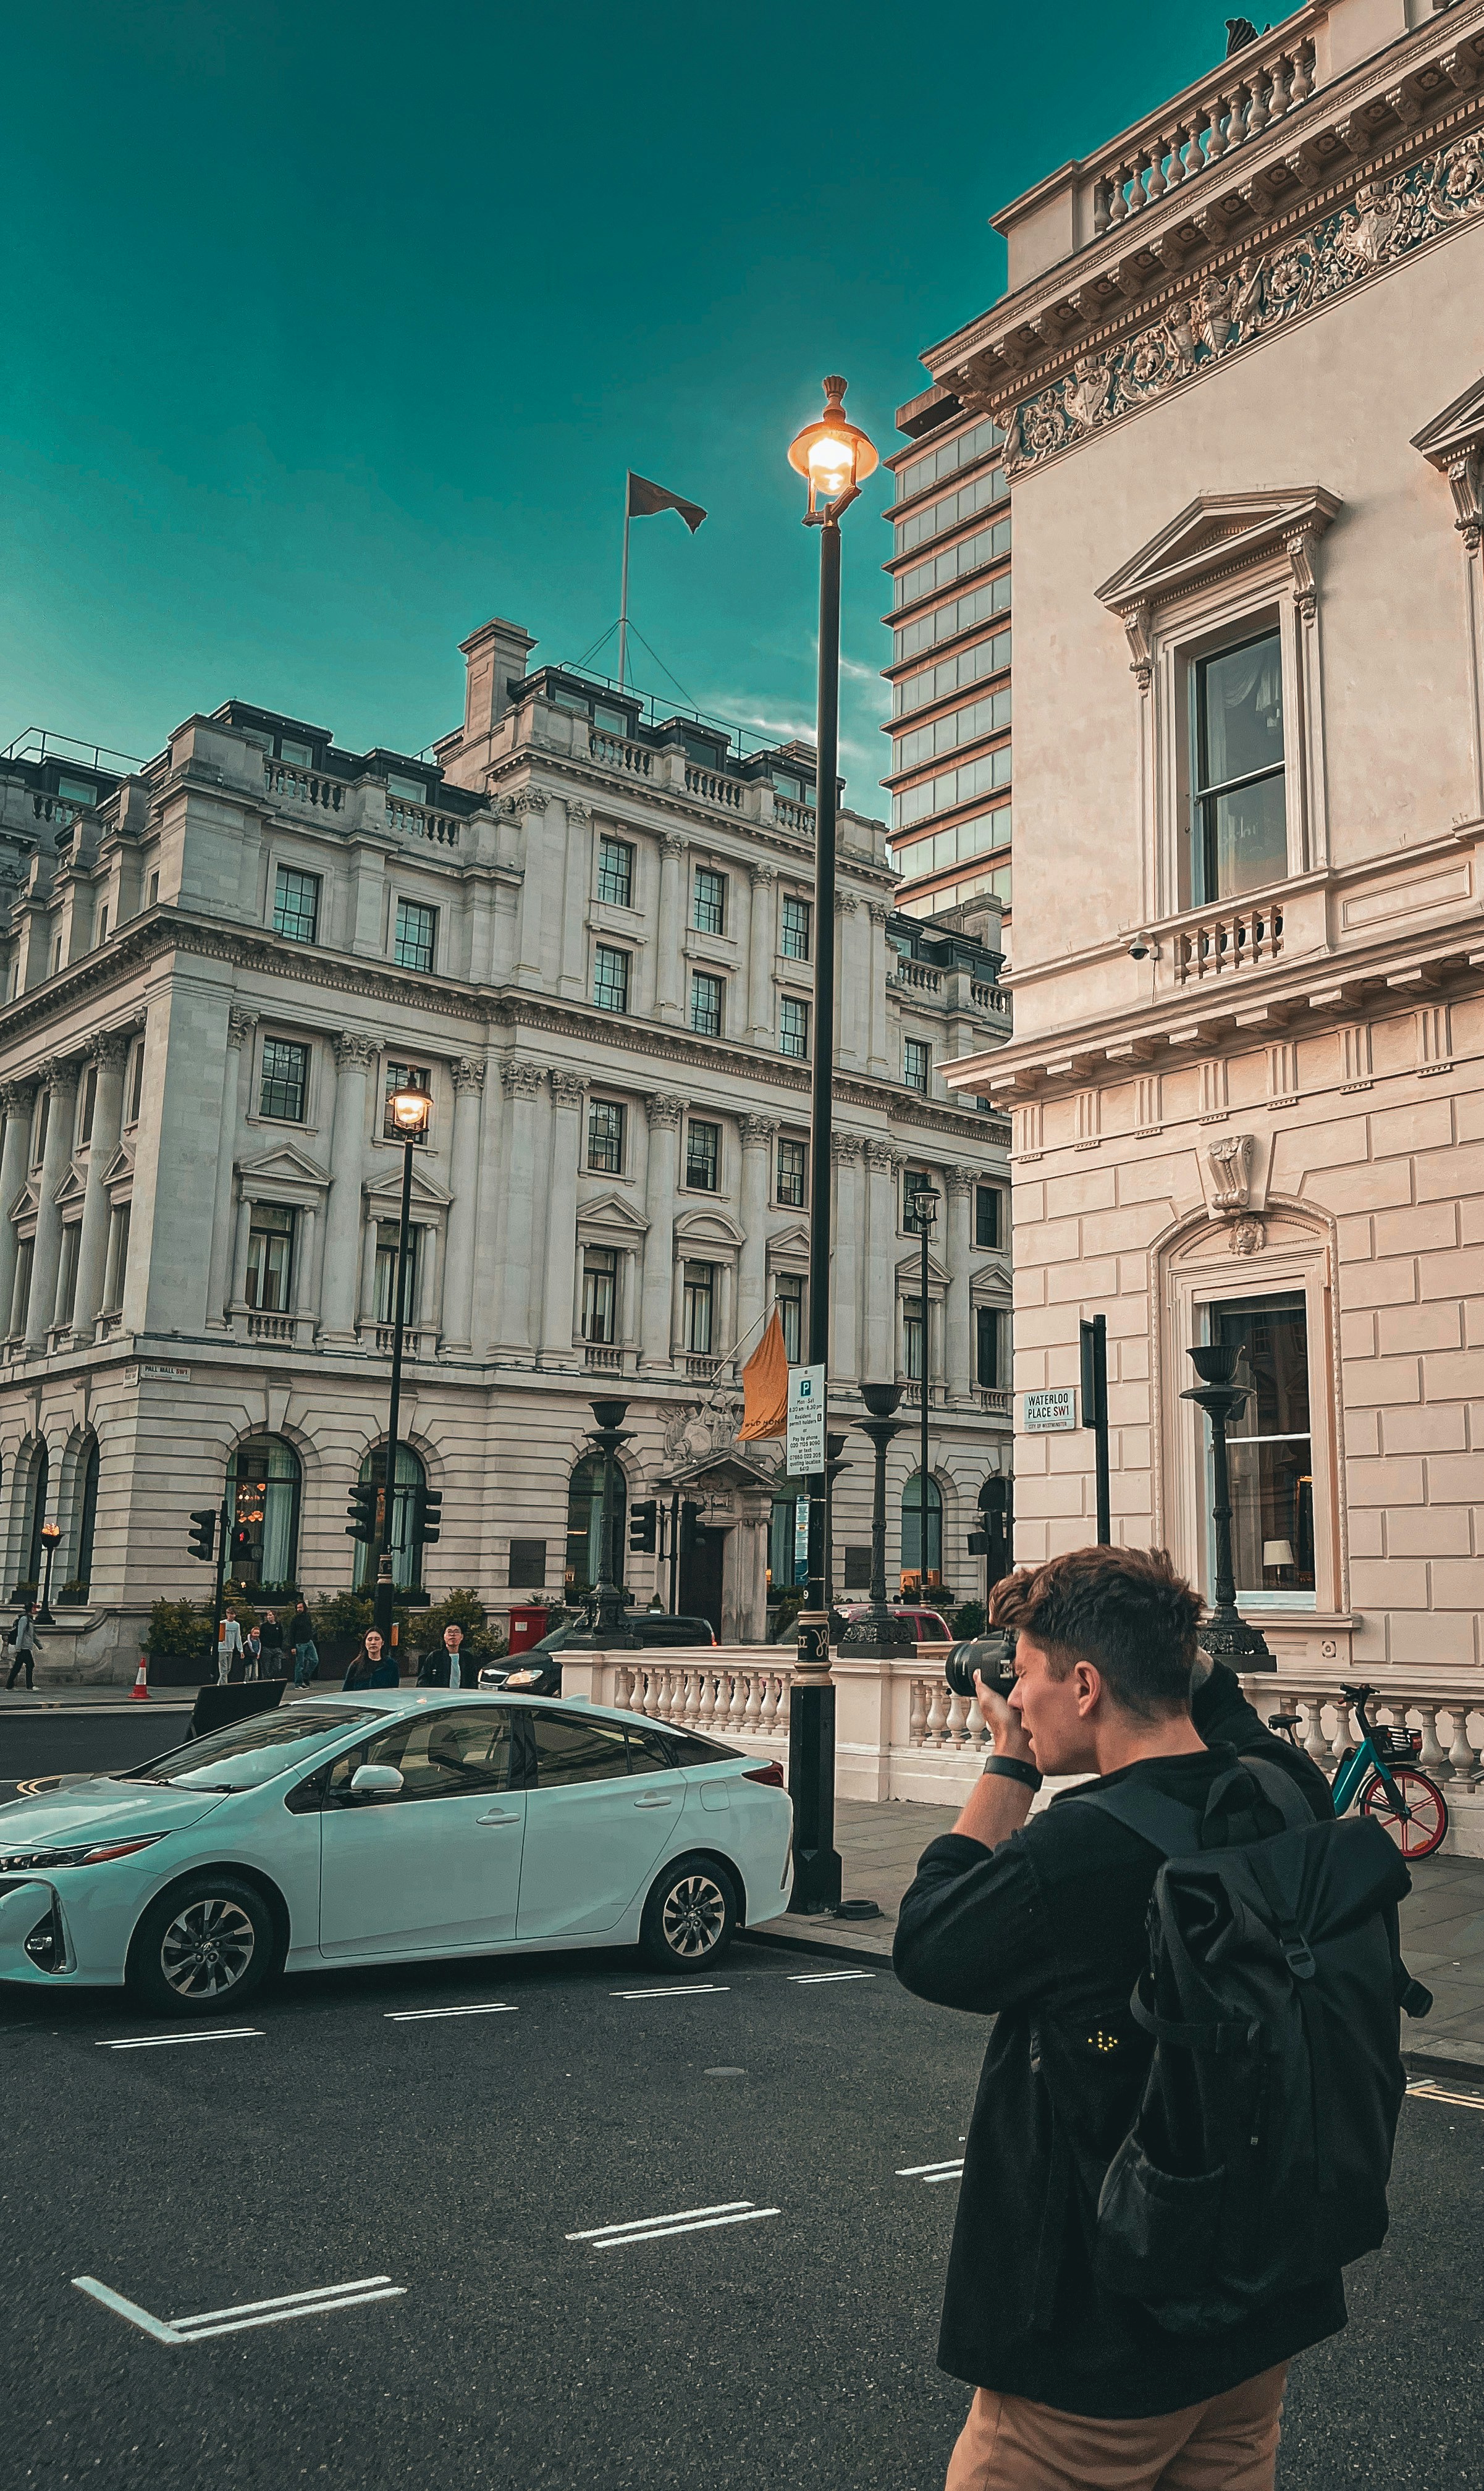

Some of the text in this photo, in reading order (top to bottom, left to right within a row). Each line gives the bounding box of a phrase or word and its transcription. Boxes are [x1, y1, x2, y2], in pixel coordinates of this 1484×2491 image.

[1028, 1393, 1068, 1406] WATERLOO
[1028, 1405, 1069, 1418] PLACE SW1
[804, 1590, 809, 1600] 9
